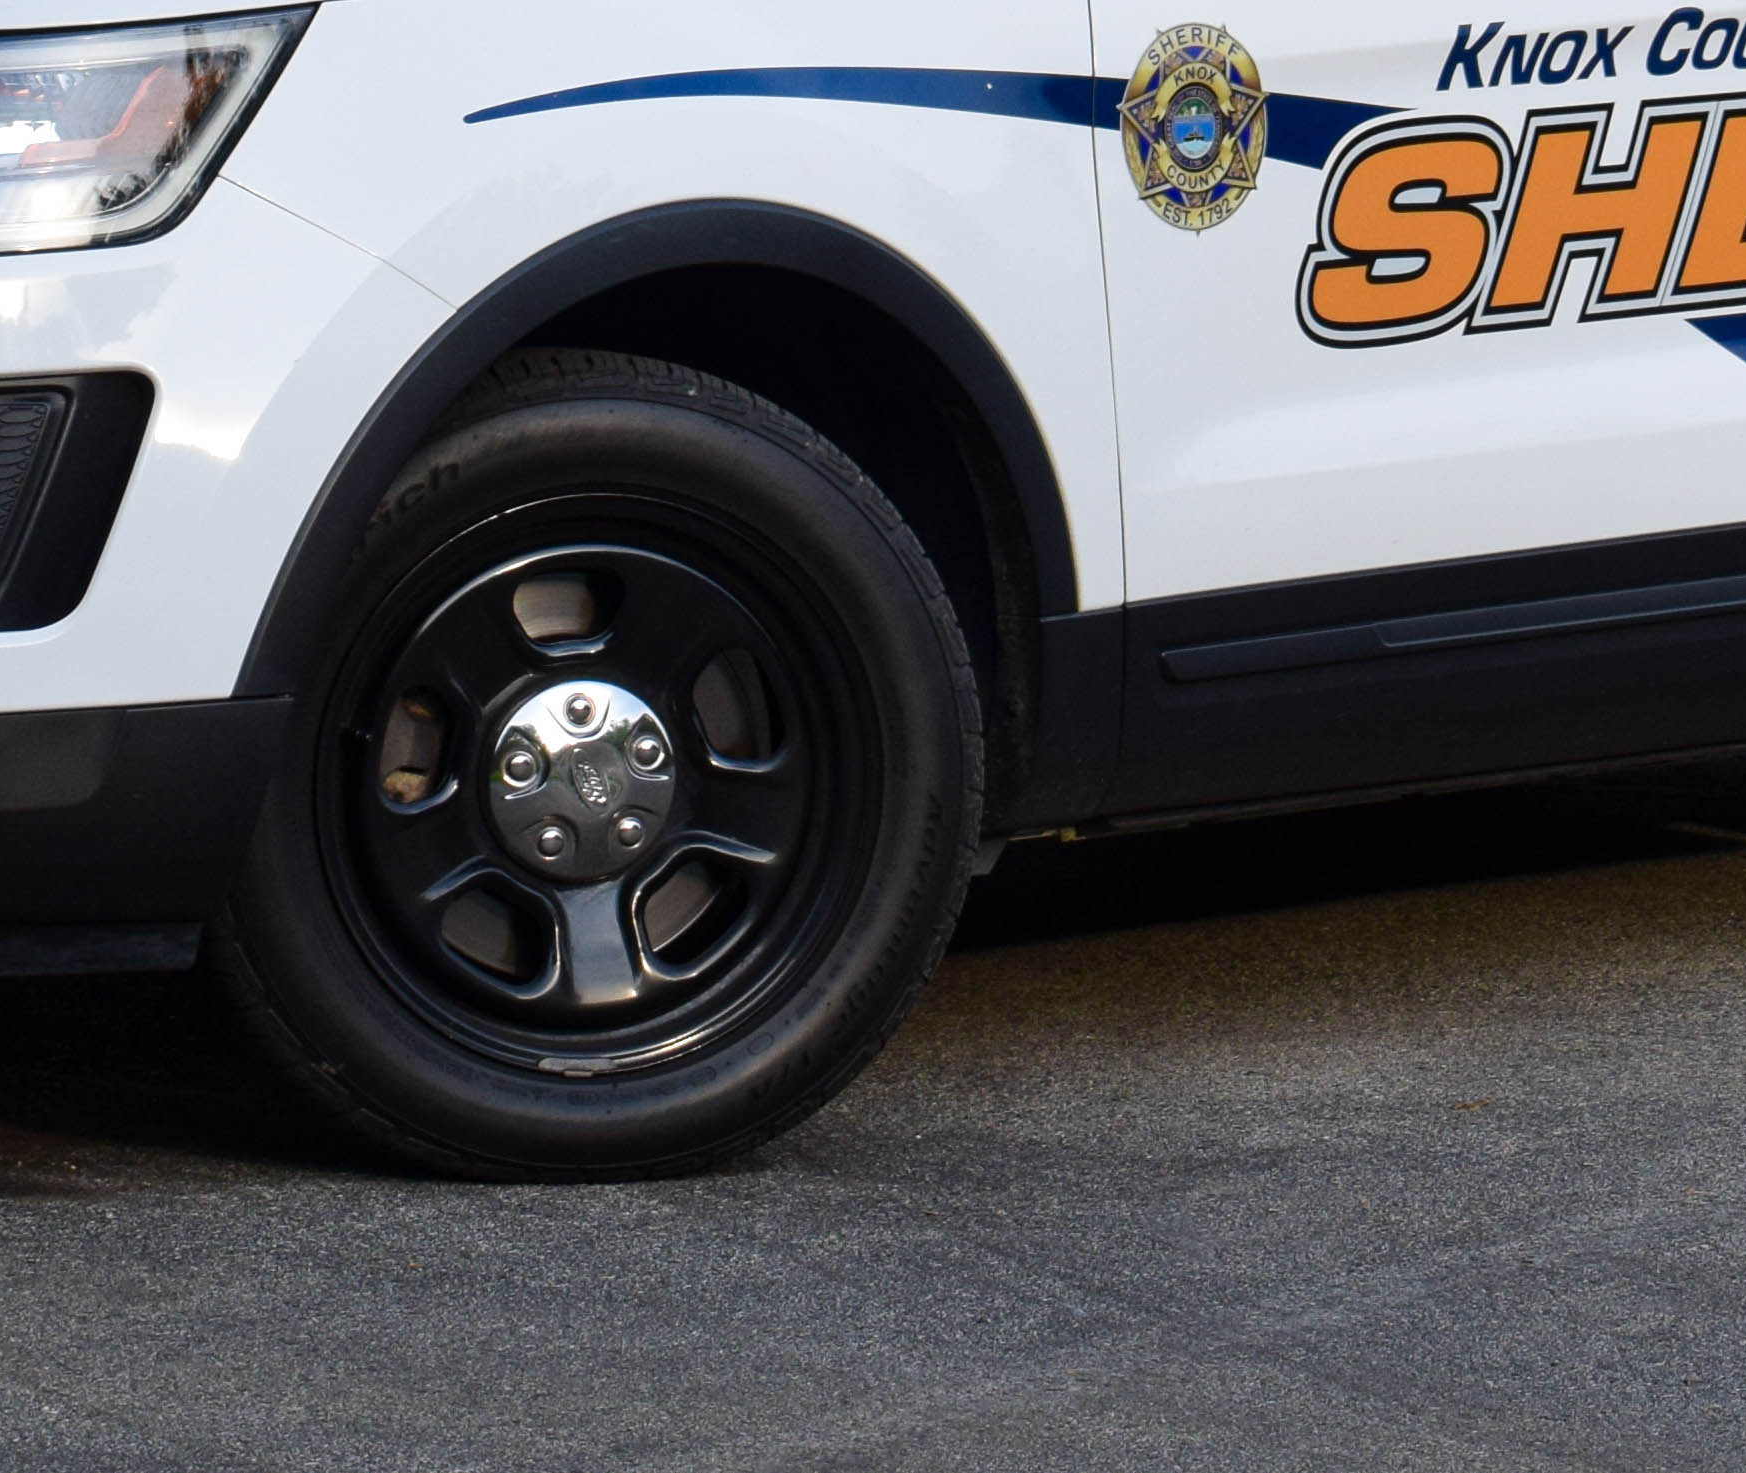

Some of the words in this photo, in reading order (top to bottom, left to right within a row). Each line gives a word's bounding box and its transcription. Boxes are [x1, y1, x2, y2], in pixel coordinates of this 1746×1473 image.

[1148, 26, 1240, 66] SHERIFF
[1173, 66, 1217, 87] KNOX
[1166, 162, 1225, 190] COUNTY
[1162, 201, 1194, 227] EST.
[1197, 198, 1234, 225] 1792
